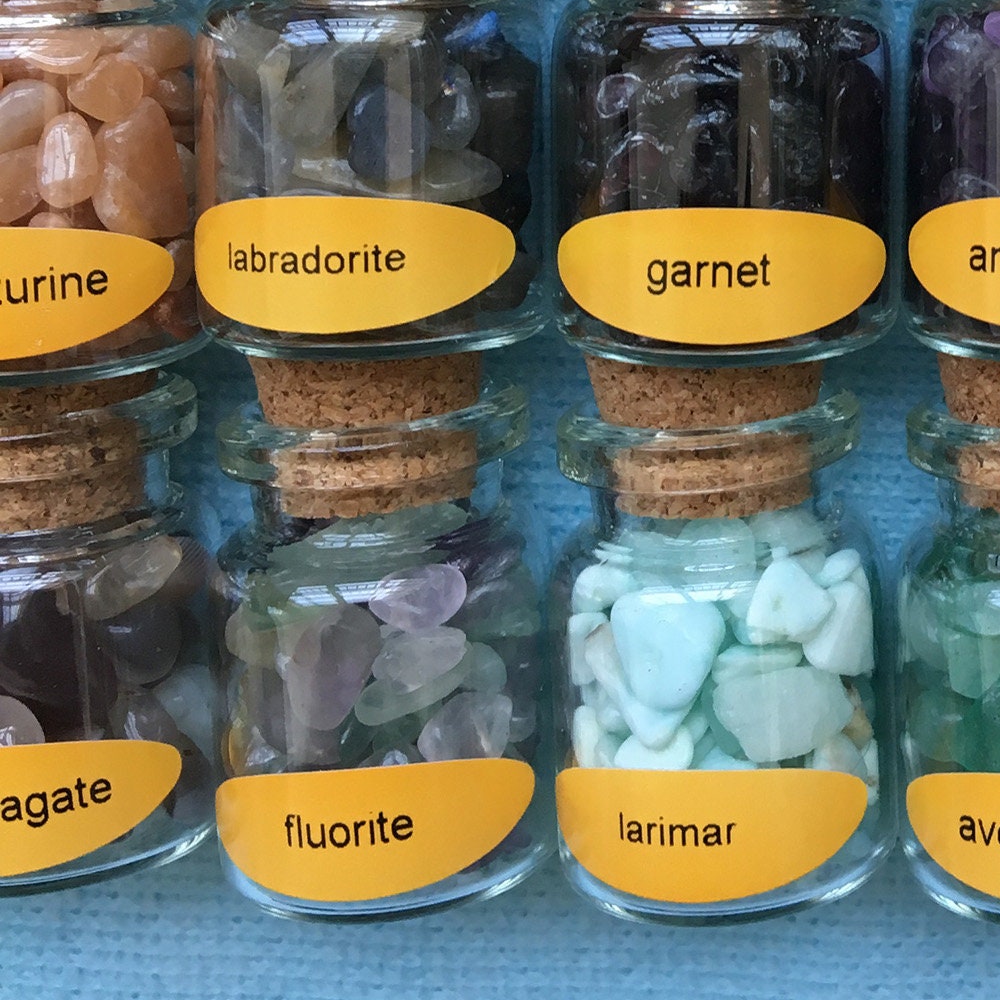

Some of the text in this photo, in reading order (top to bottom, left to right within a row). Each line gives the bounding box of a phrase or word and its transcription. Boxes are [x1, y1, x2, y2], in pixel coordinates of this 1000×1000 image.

[228, 243, 406, 275] labradorite
[647, 253, 771, 296] garnet
[0, 266, 109, 306] urine
[0, 777, 112, 829] agate
[284, 811, 414, 849] fluorite
[619, 812, 736, 847] larimar
